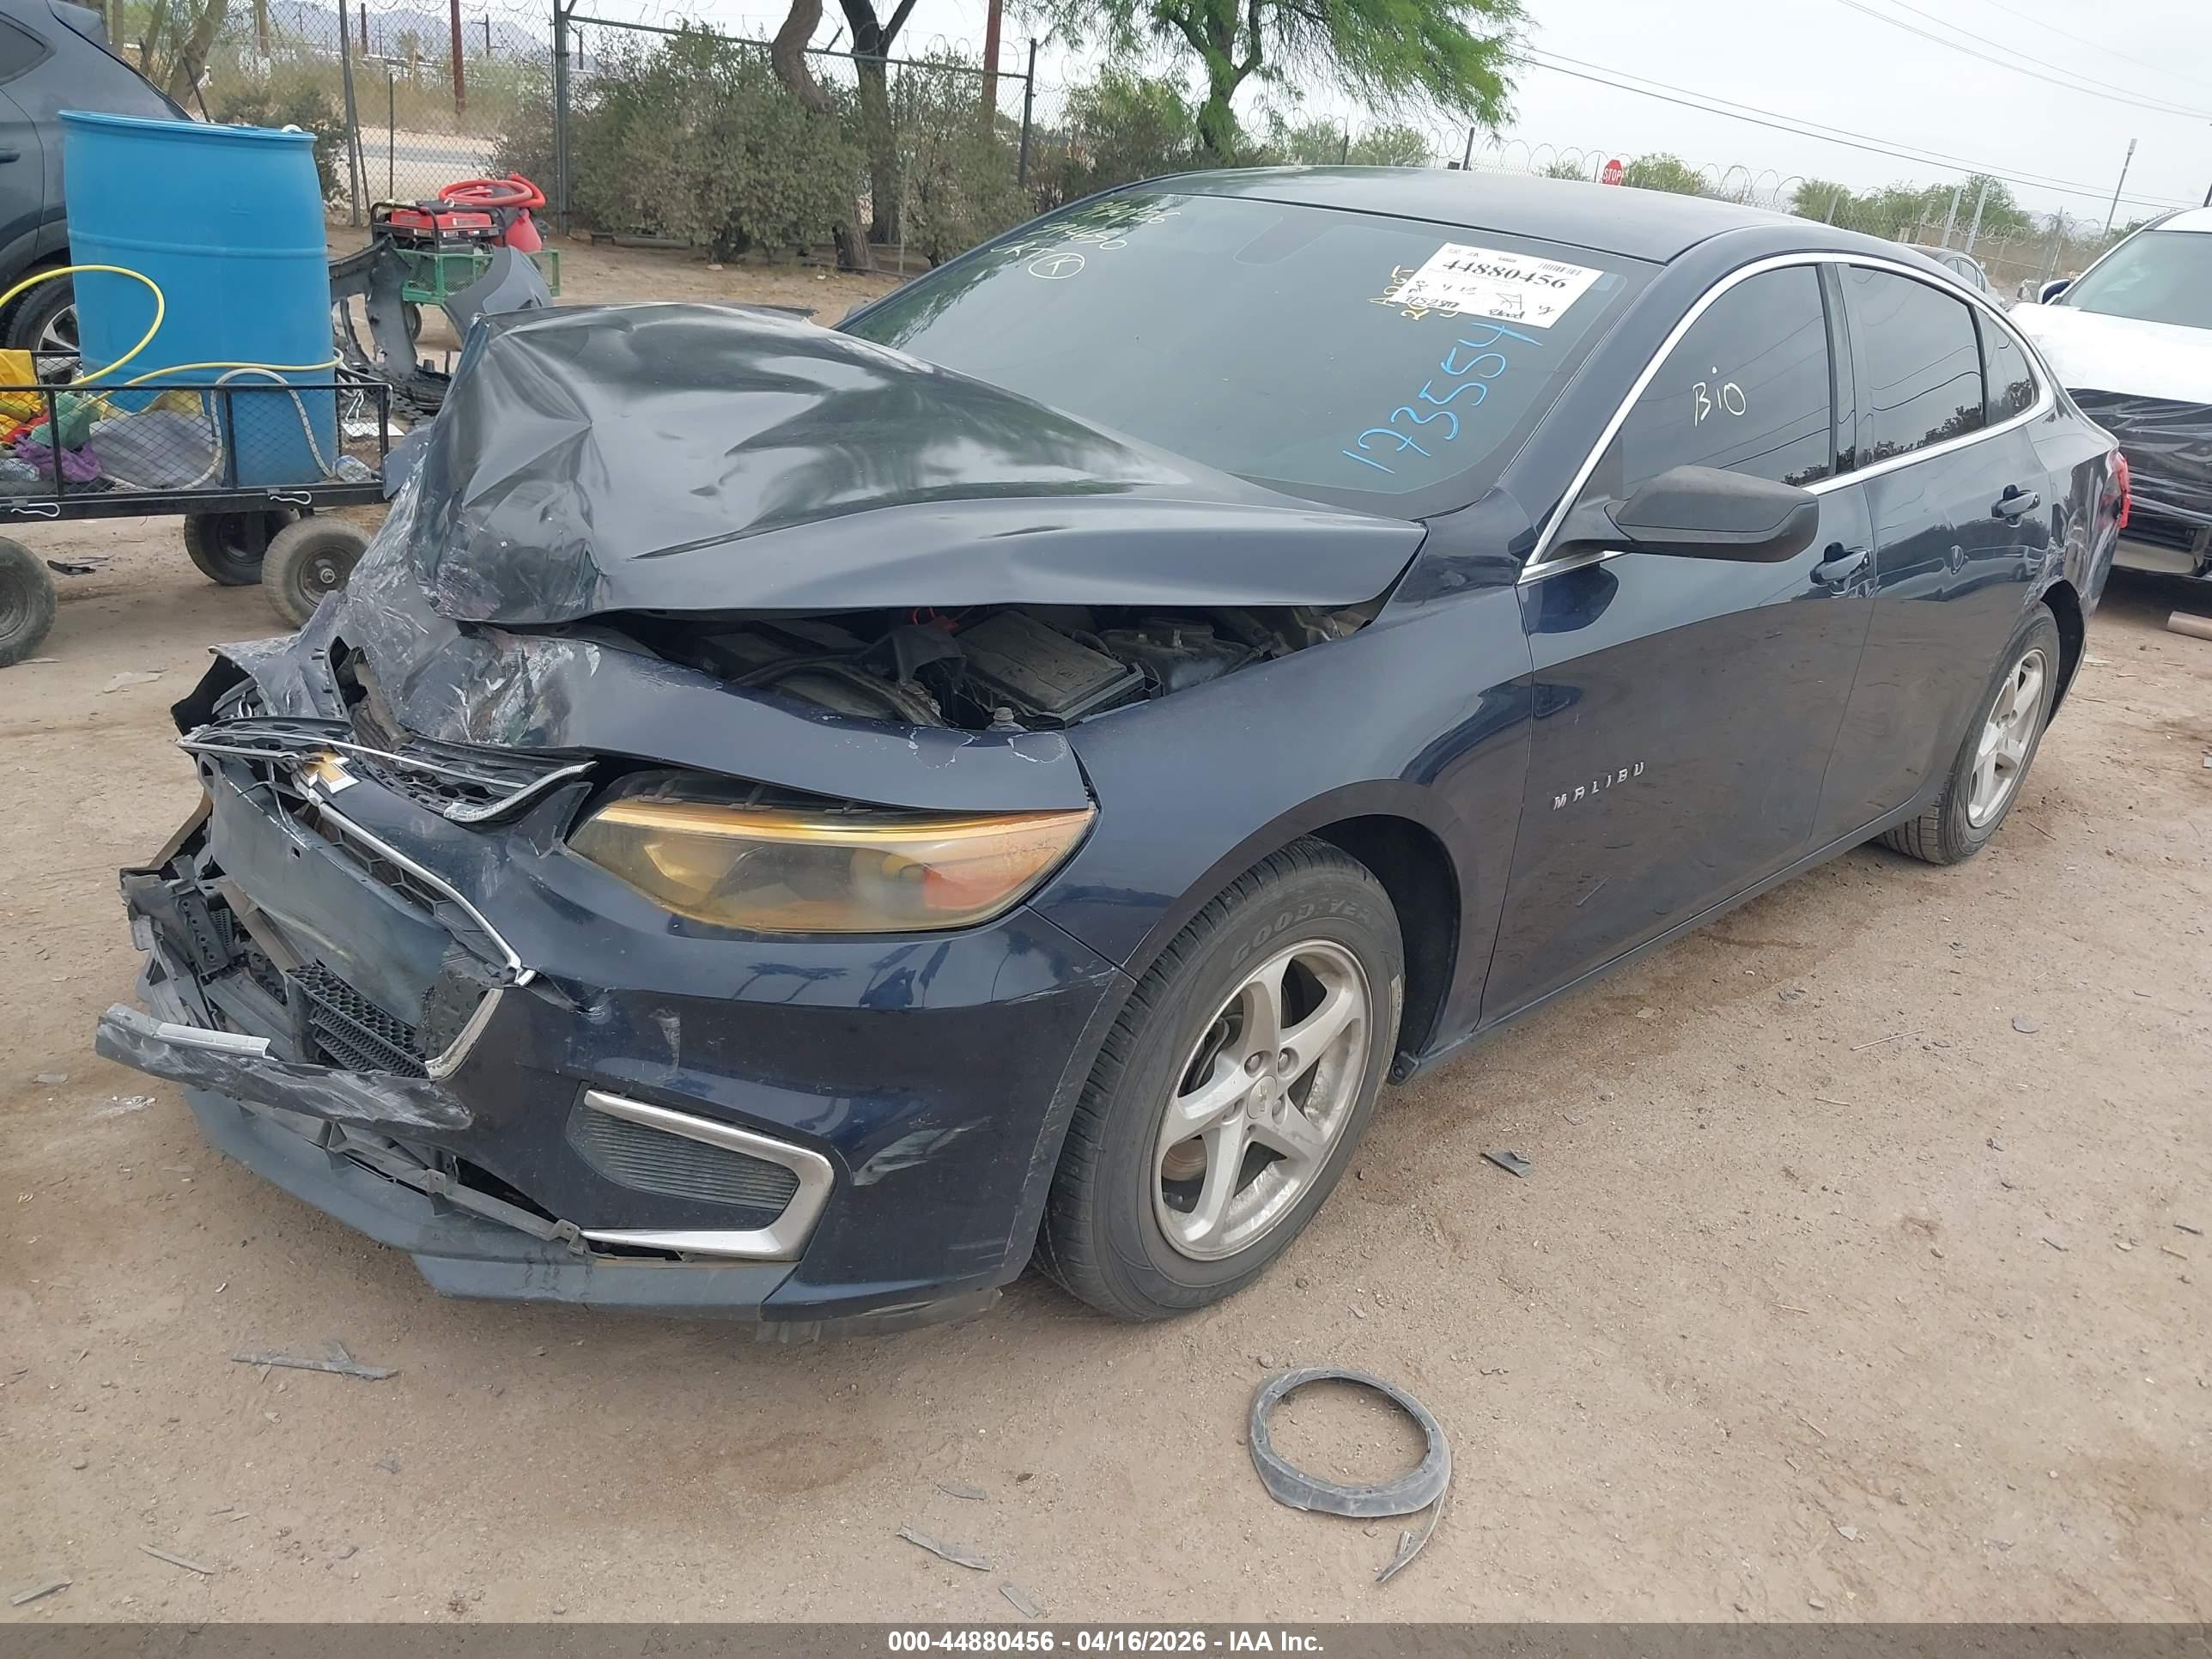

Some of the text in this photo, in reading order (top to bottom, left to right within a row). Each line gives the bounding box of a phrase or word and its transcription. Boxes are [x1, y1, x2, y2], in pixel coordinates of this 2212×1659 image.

[1603, 167, 1622, 182] STOP
[1443, 259, 1567, 289] 44880456
[1342, 323, 1543, 473] 173554
[1553, 762, 1644, 811] MALIBU
